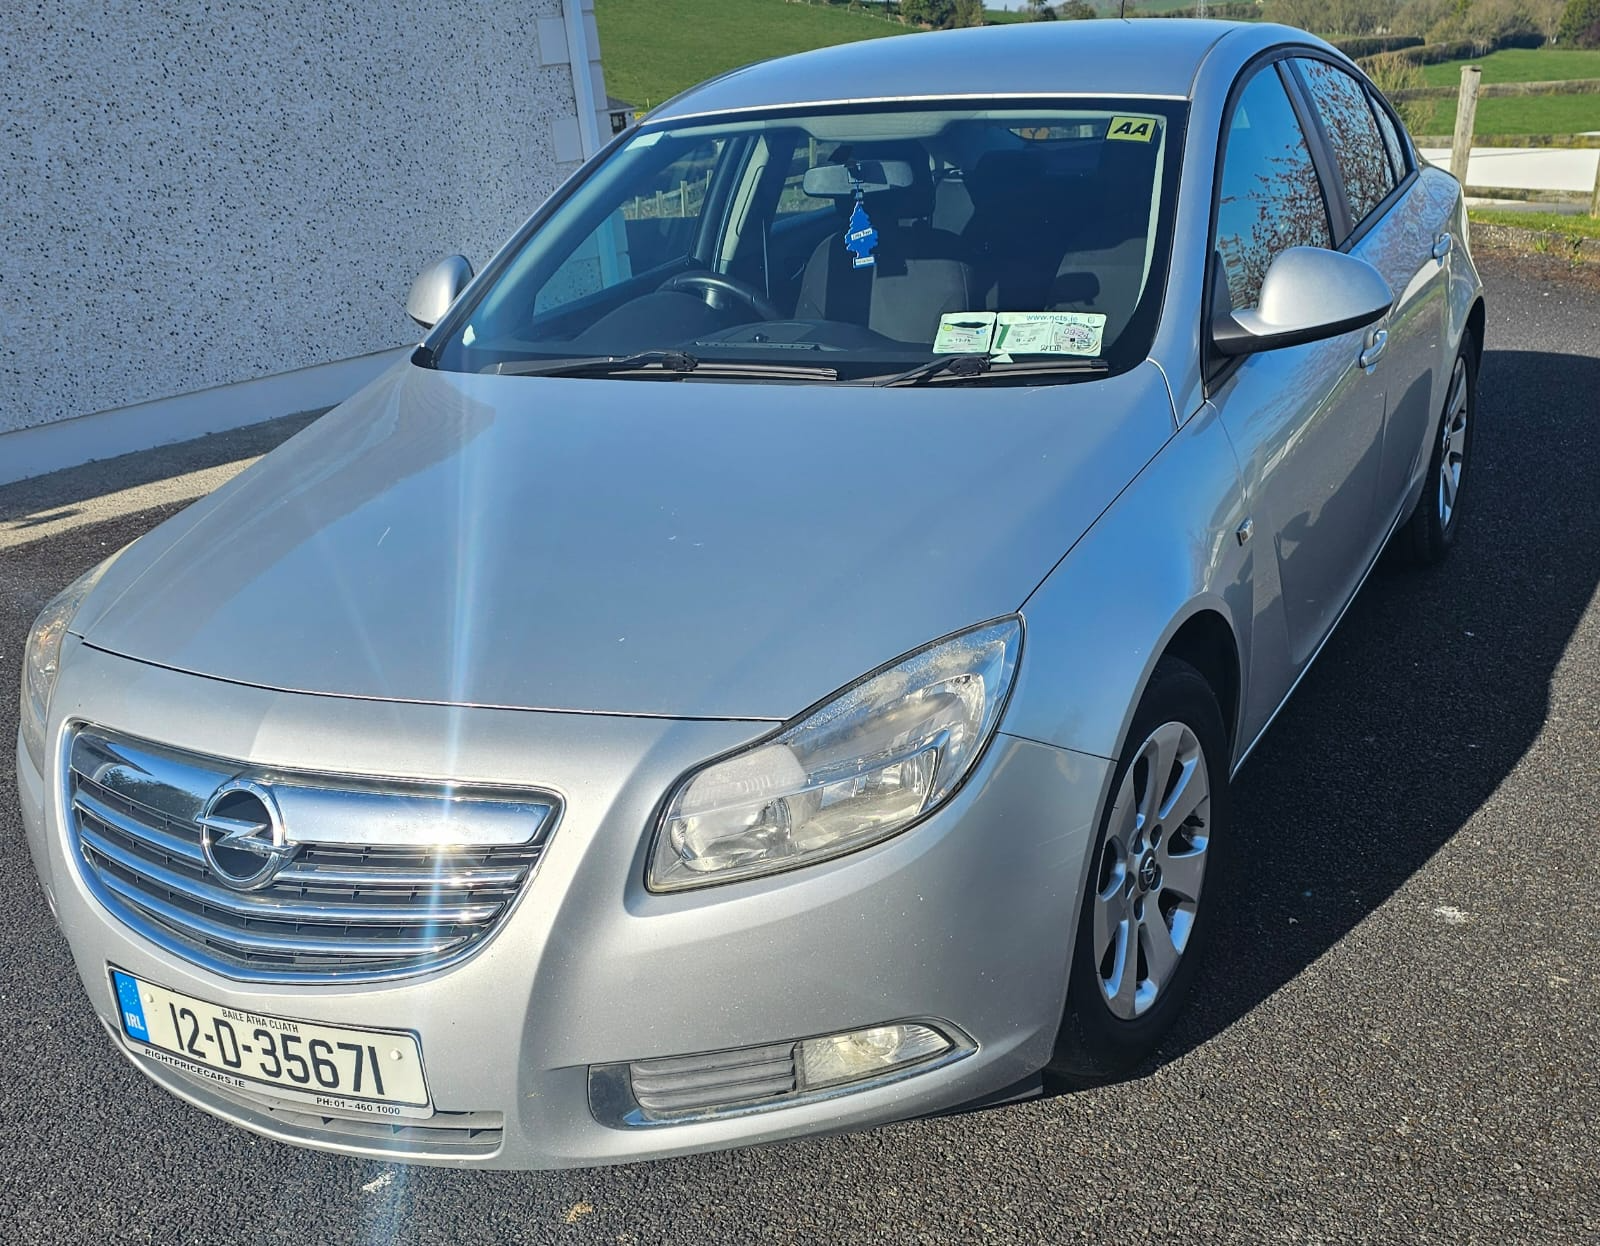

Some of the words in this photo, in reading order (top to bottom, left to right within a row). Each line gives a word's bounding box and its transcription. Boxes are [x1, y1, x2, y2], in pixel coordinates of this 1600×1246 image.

[1113, 121, 1149, 136] AA
[125, 1011, 145, 1031] IRL
[221, 1008, 244, 1022] BAILE
[269, 1019, 299, 1034] CLIATH
[169, 1002, 385, 1096] 12-D-35671
[144, 1048, 246, 1088] RIGHTPRICECARS.IE
[376, 1106, 400, 1115] 1000
